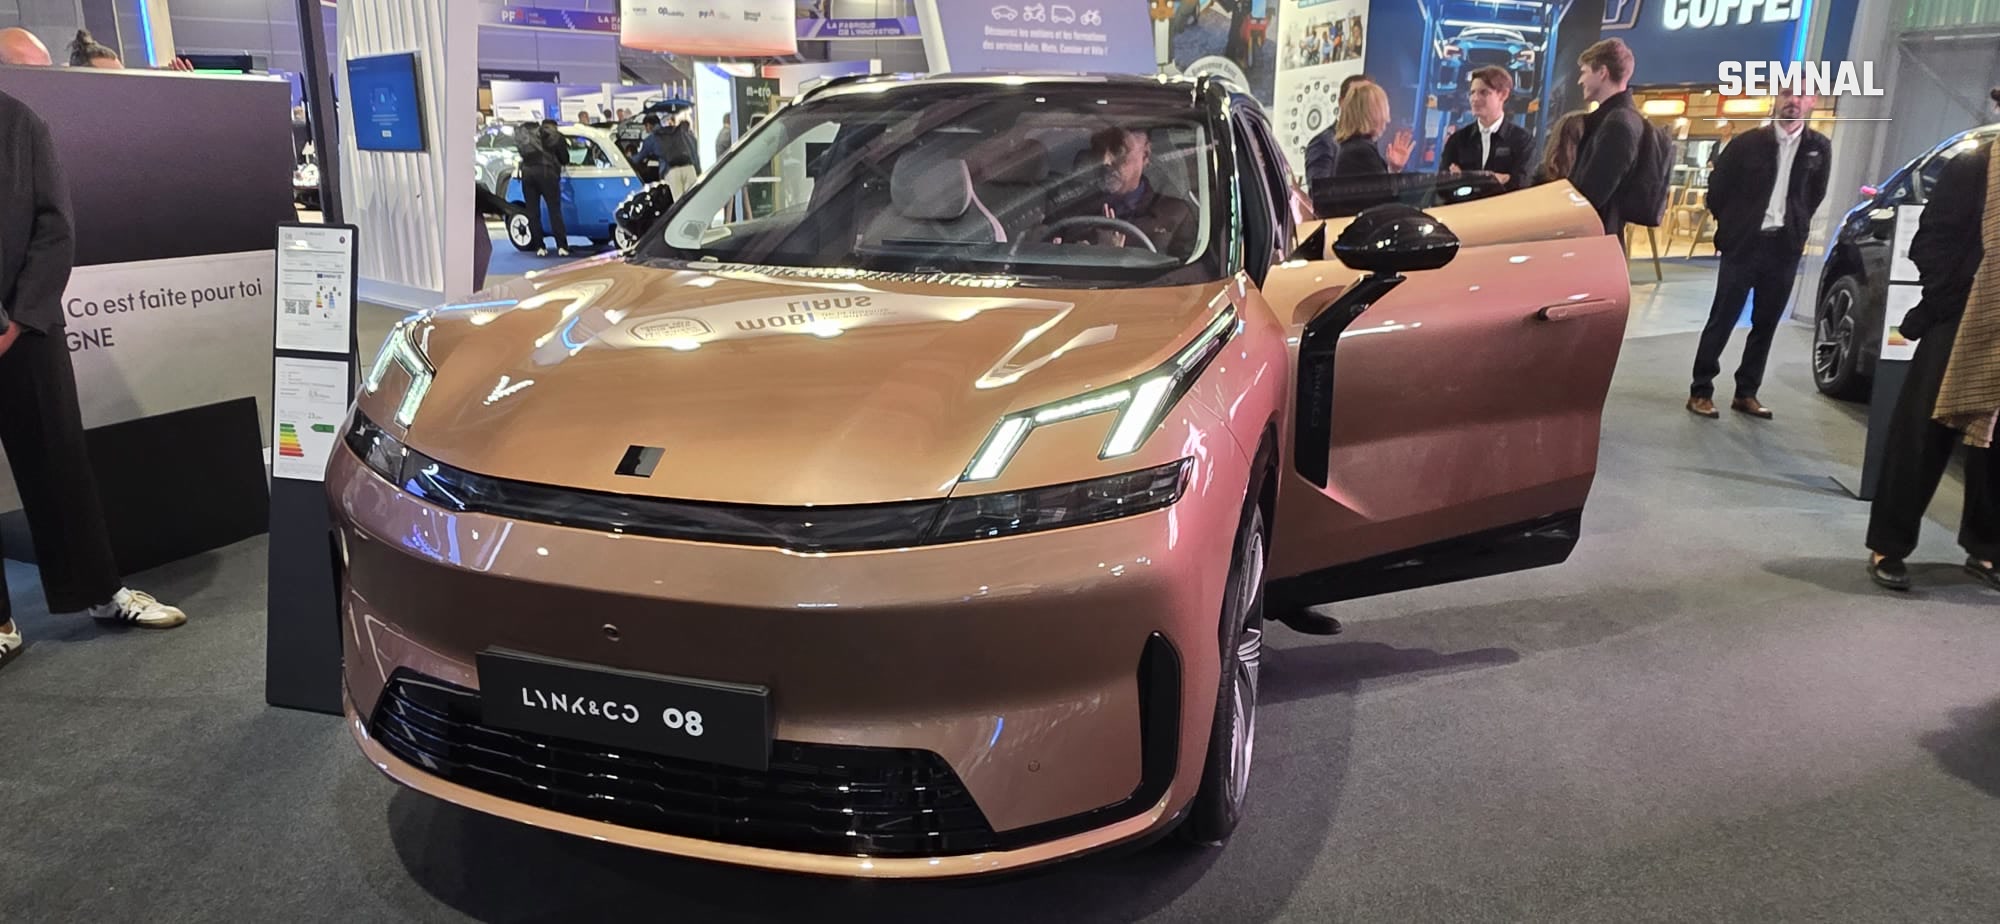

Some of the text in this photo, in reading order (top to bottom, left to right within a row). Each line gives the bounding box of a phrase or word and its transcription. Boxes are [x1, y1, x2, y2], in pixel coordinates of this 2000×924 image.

[502, 6, 524, 22] PFA
[67, 278, 262, 318] Co est faite pour toi
[522, 687, 704, 736] LYNK&CO 08
